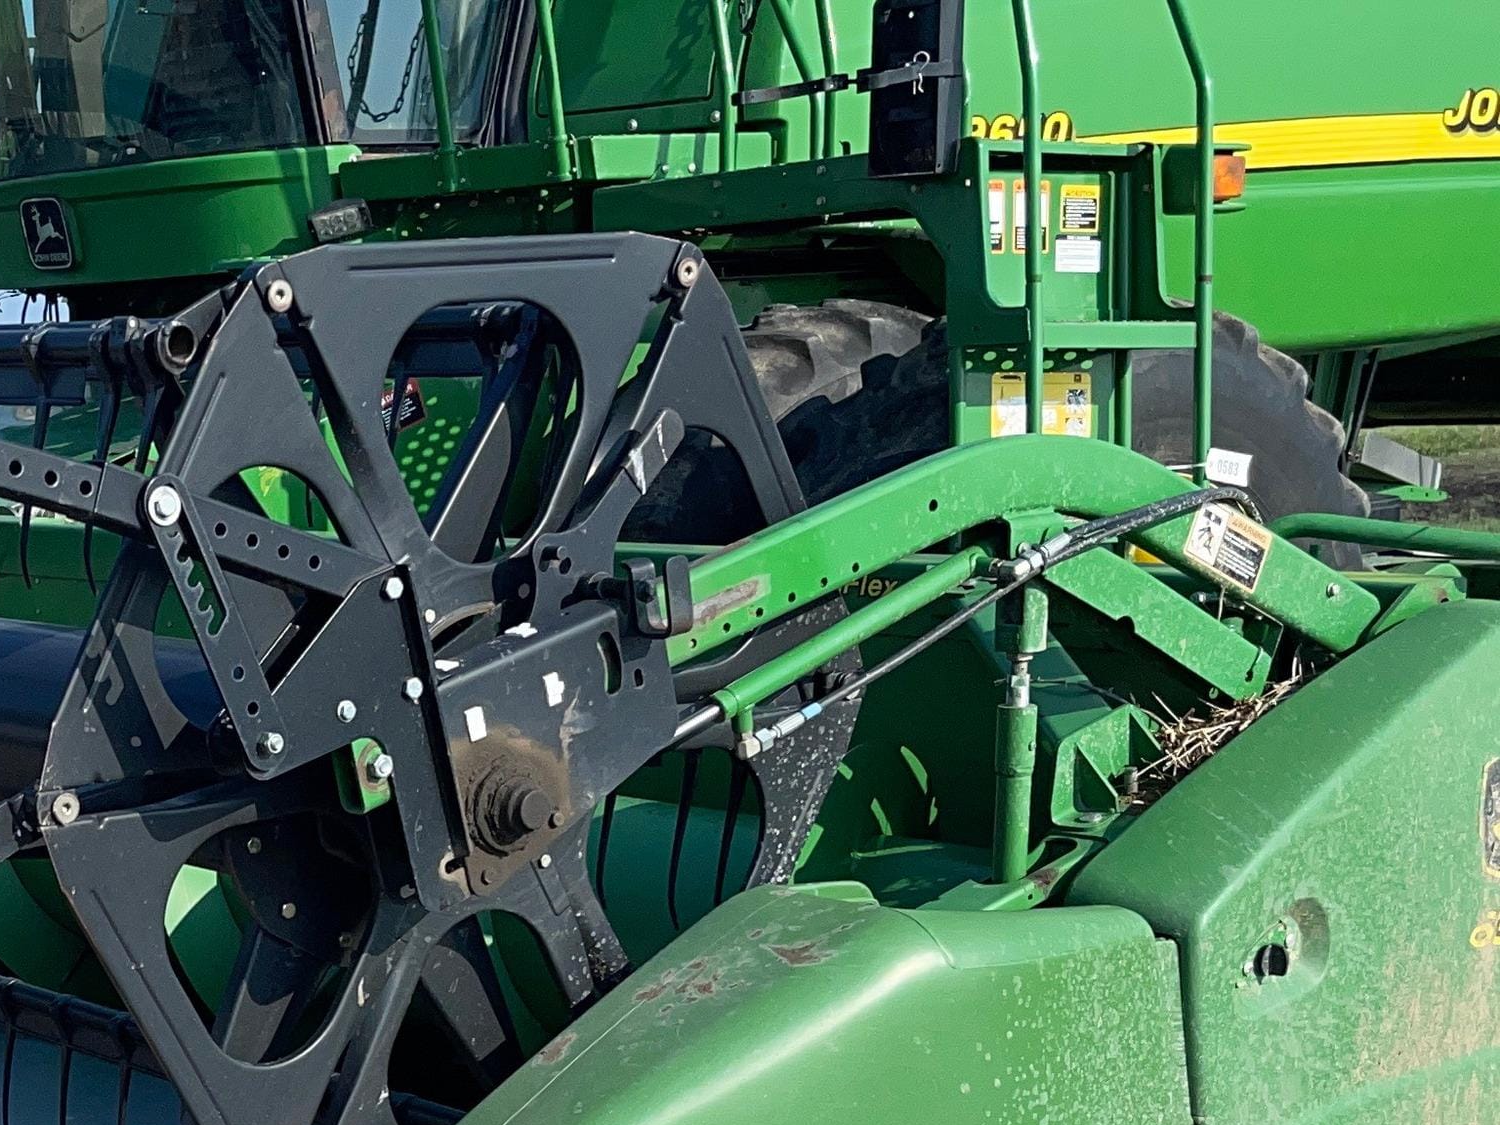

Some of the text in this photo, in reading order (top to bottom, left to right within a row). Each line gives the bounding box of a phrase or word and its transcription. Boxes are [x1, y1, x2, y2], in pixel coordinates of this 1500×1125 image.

[1443, 88, 1500, 133] JO
[971, 112, 1073, 141] 60
[1217, 459, 1239, 476] 0583
